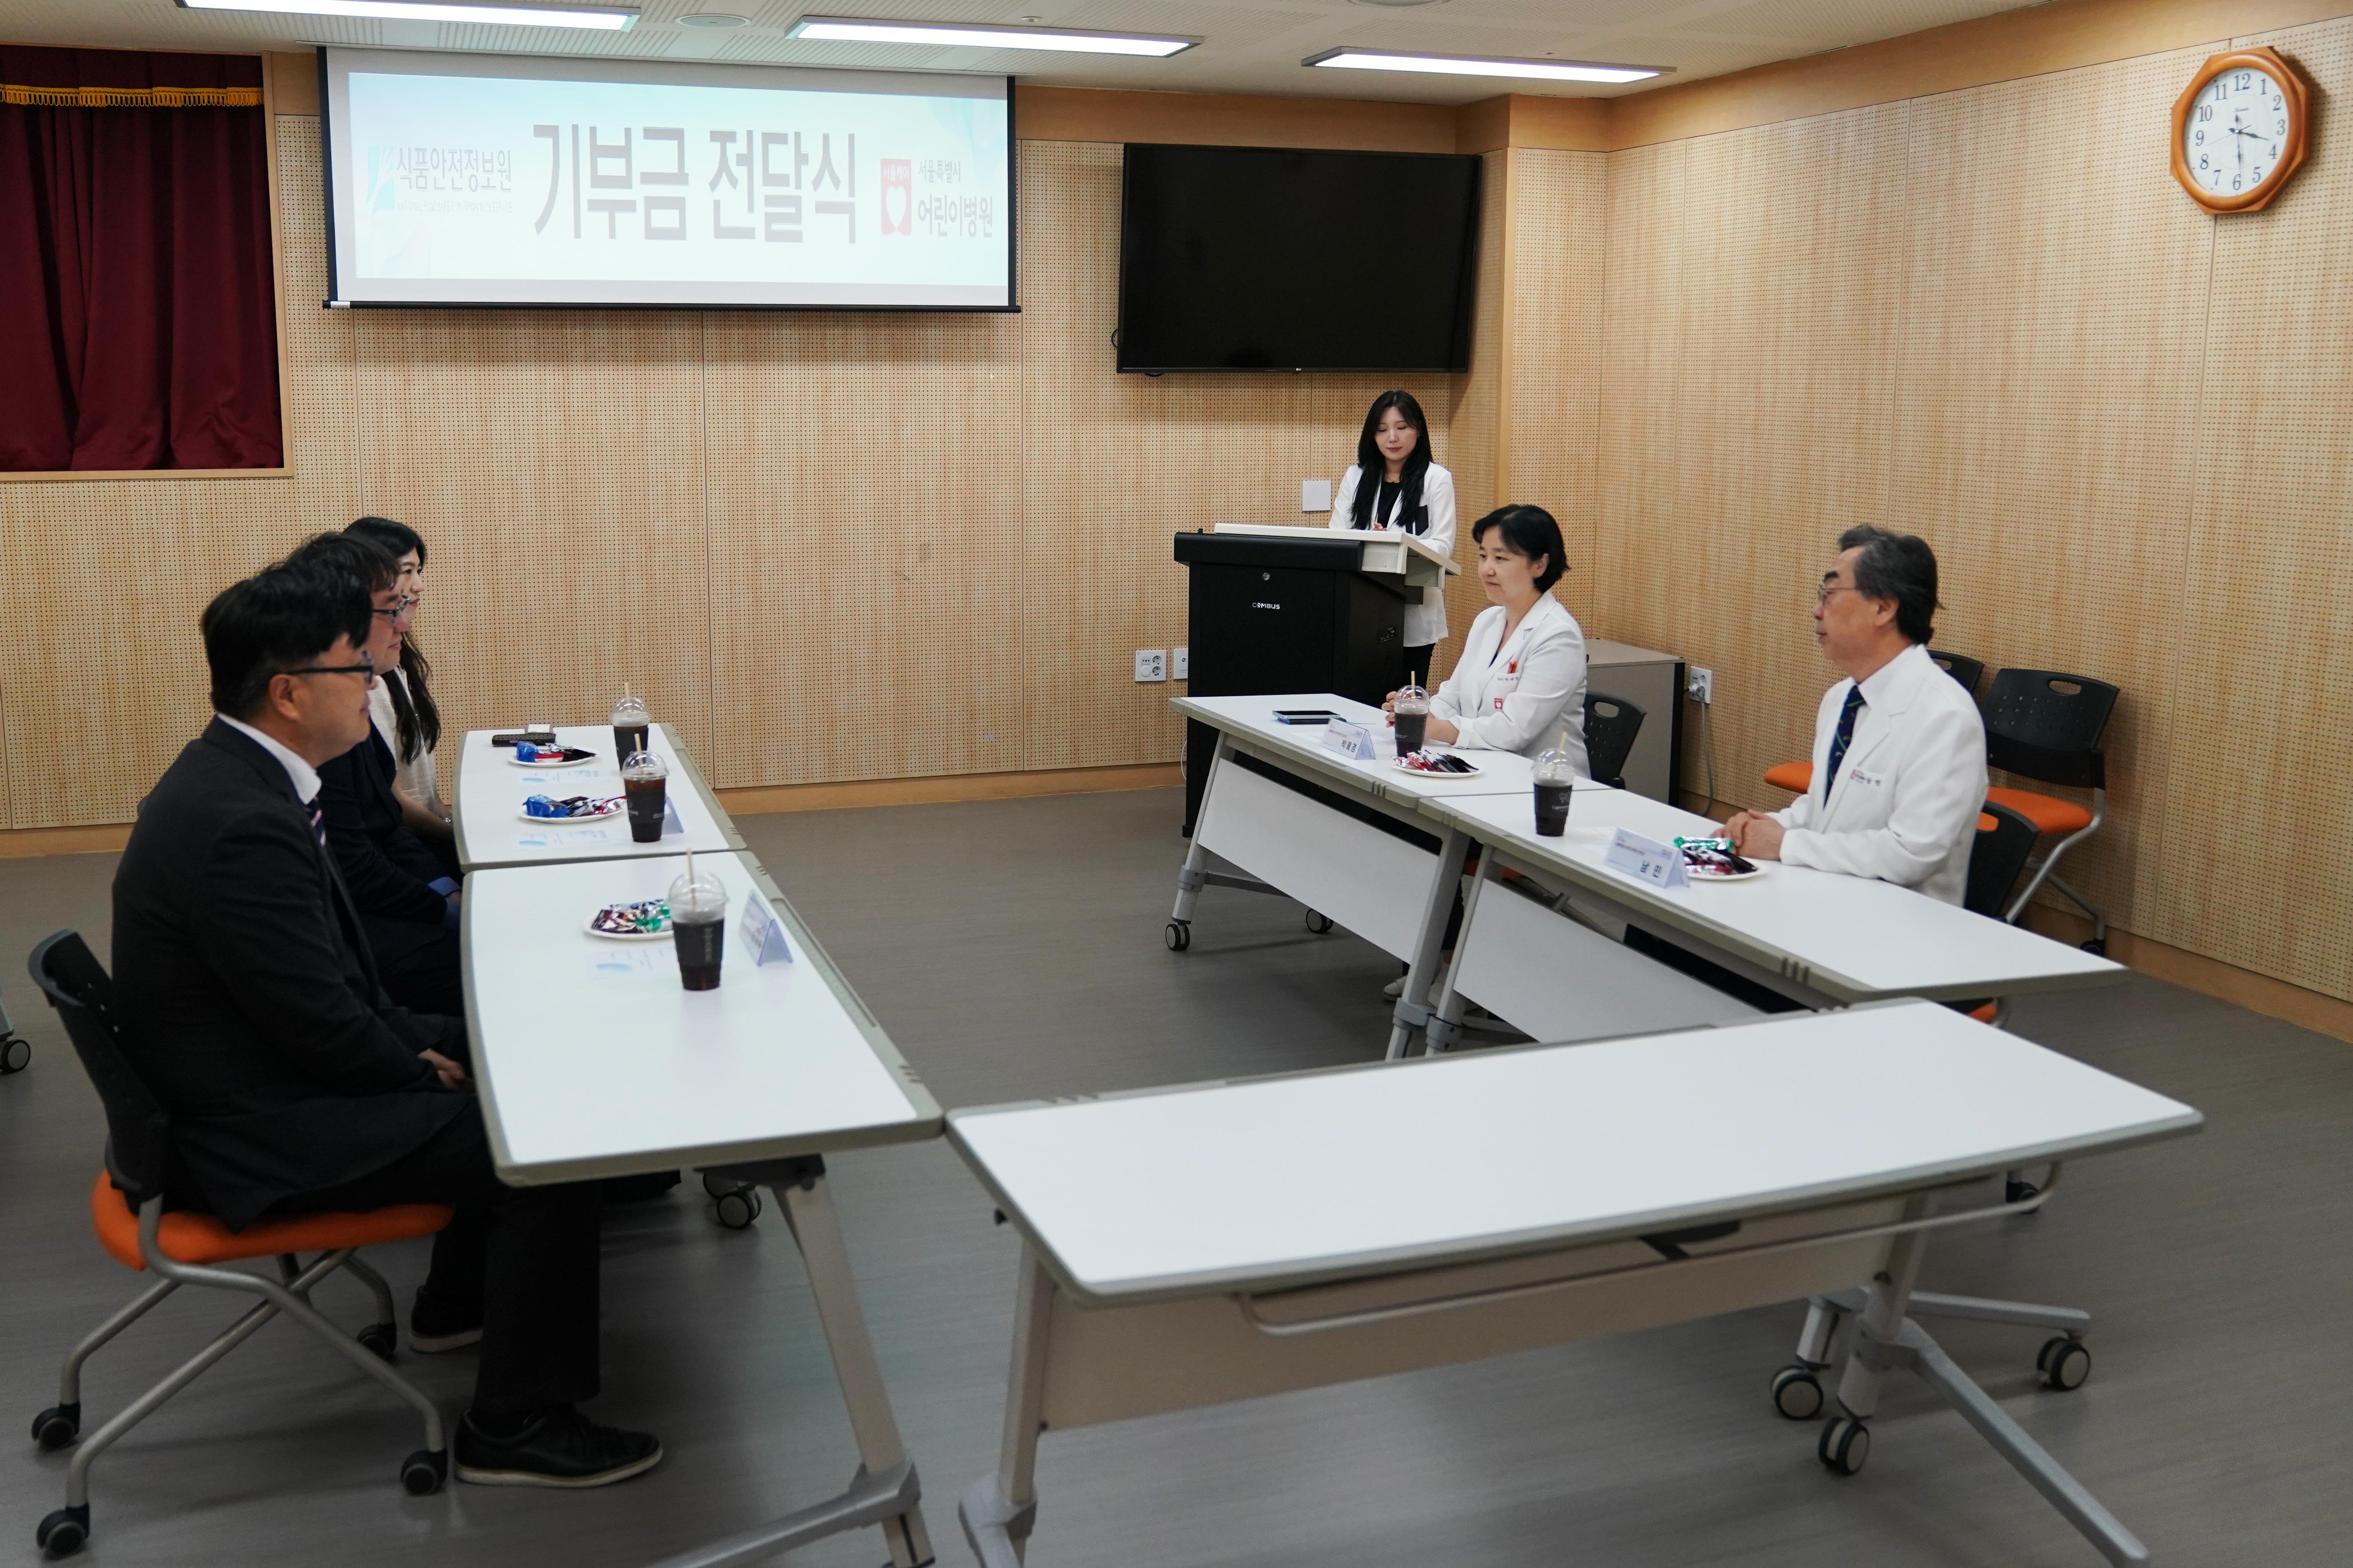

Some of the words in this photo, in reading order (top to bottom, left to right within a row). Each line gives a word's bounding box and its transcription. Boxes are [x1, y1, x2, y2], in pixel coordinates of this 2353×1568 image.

[2234, 73, 2251, 91] 12
[2260, 78, 2267, 95] 1
[2214, 83, 2227, 101] 11
[2273, 95, 2282, 111] 2
[2198, 105, 2213, 122] 10
[2277, 119, 2286, 135] 3
[2195, 130, 2204, 146] 9
[2268, 143, 2278, 160] 4
[397, 147, 512, 192] 식품안전정보원
[2200, 154, 2209, 170] 8
[918, 160, 960, 184] 서울특별시
[2213, 170, 2222, 186] 7
[2252, 166, 2261, 183] 5
[533, 123, 689, 241] 기부금
[709, 129, 856, 244] 전달식
[2233, 174, 2241, 190] 6
[918, 194, 993, 238] 어린이병원
